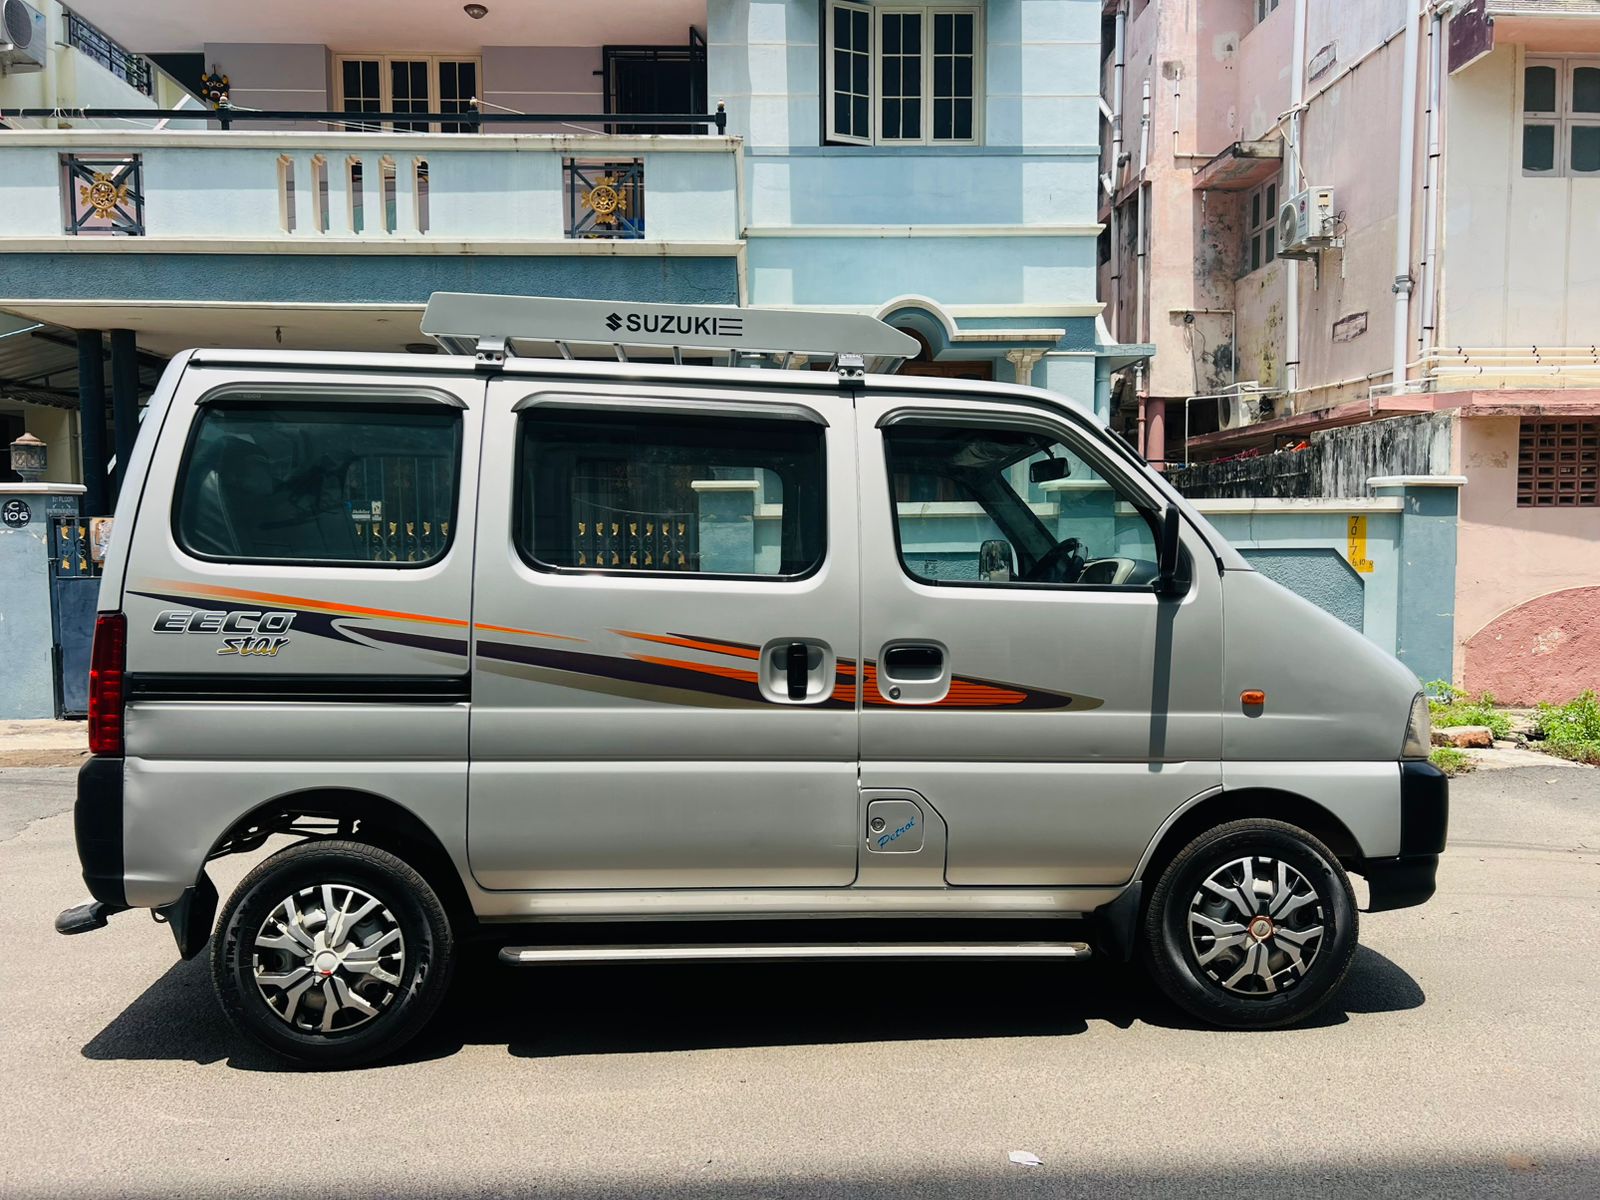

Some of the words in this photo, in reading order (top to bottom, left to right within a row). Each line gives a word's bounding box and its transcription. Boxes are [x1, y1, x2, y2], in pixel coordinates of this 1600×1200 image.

[626, 313, 717, 336] SUZUKI
[3, 512, 29, 521] 106
[152, 610, 297, 634] EECO
[877, 815, 916, 849] Petrol
